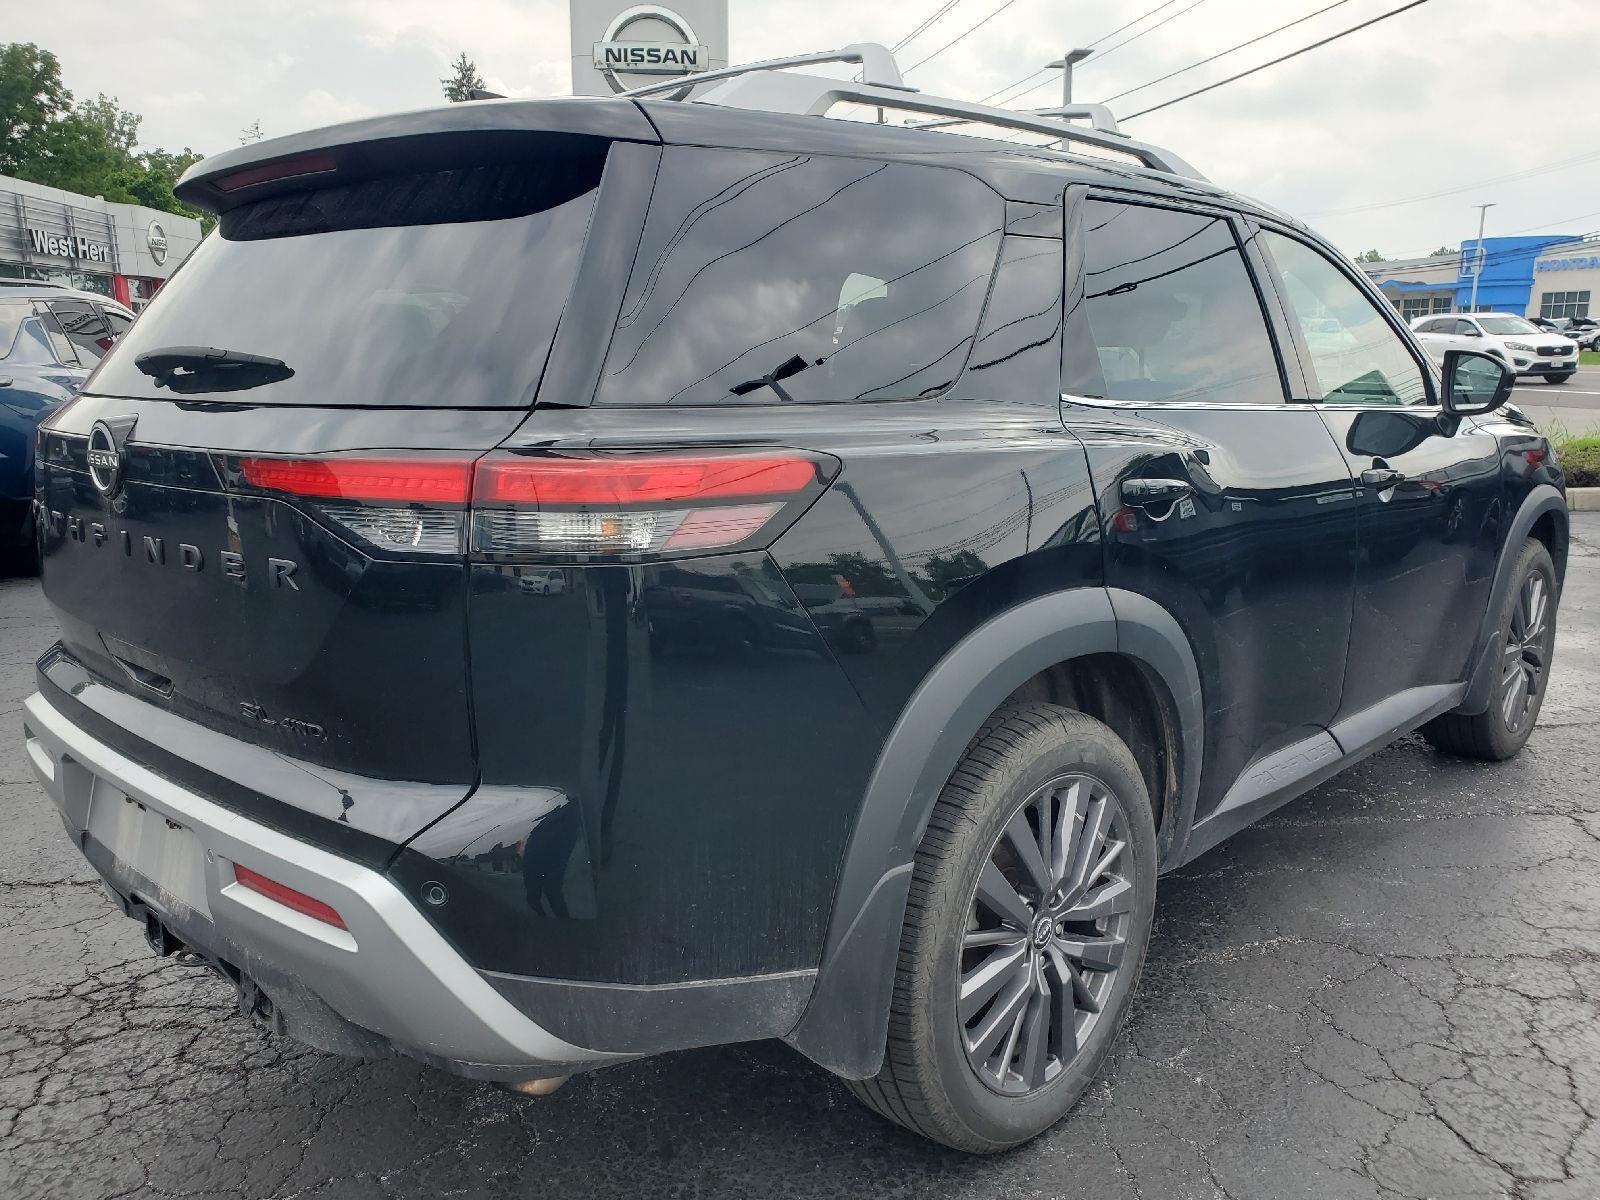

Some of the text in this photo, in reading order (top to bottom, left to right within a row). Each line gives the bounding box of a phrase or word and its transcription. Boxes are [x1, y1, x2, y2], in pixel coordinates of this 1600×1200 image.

[604, 47, 697, 65] NISSAN
[30, 229, 109, 262] West Herr
